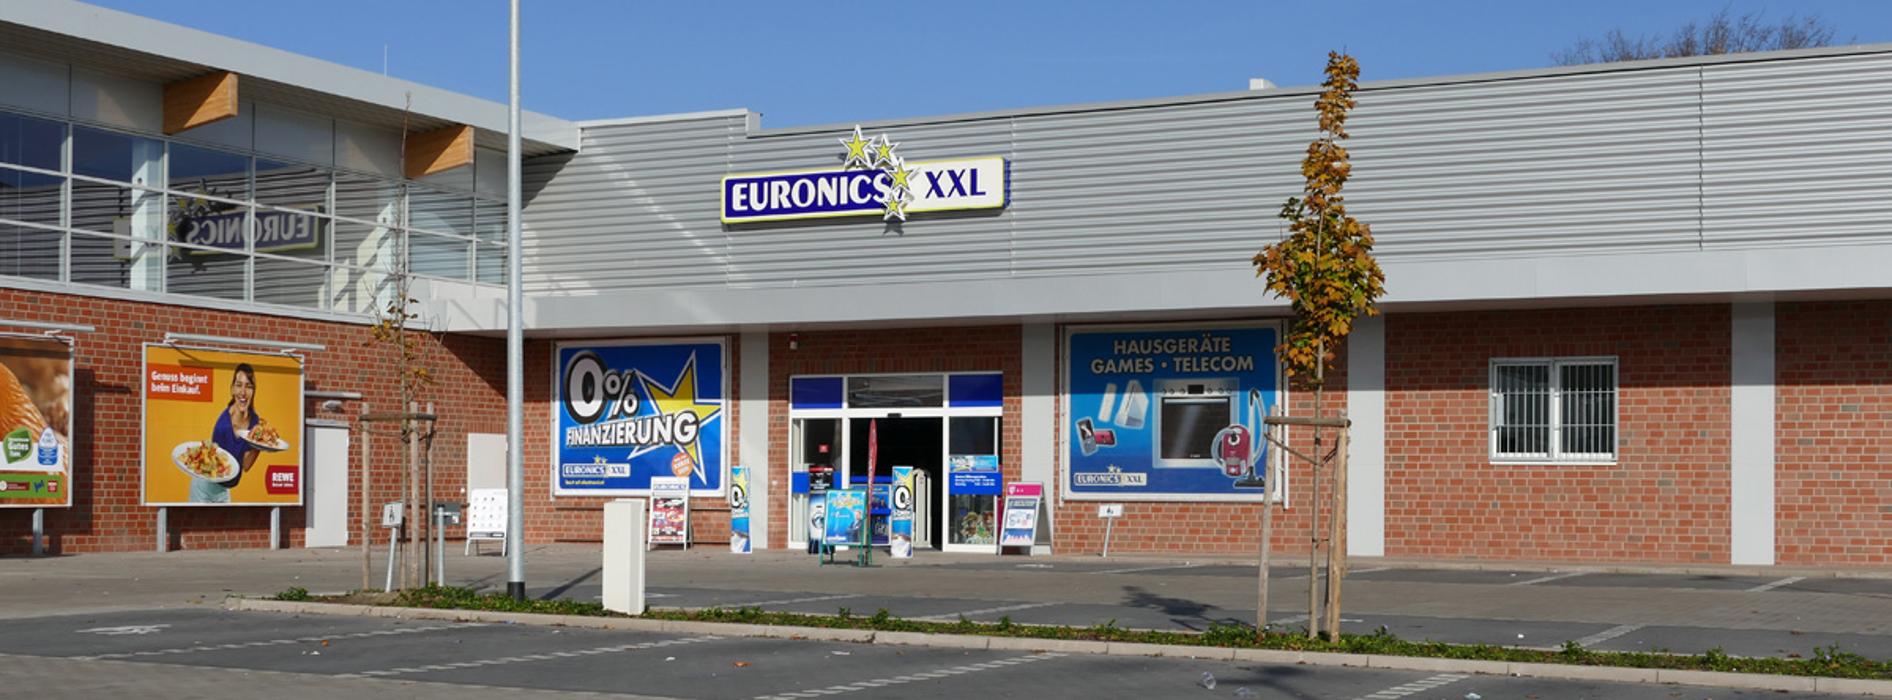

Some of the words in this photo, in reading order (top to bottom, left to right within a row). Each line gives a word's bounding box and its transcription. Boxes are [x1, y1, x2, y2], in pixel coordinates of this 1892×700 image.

[732, 173, 892, 212] EURONICS
[925, 168, 986, 199] XXL
[1113, 333, 1231, 355] HAUSGERÄTE
[1091, 358, 1154, 374] GAMES
[1173, 355, 1253, 372] TELECOM
[151, 371, 178, 382] Genuss
[180, 372, 208, 384] beginnt
[151, 382, 170, 392] beim
[172, 383, 200, 395] Einkauf.
[564, 351, 641, 424] 0%
[566, 410, 700, 446] FINANZIERUNG
[272, 472, 294, 481] REWE
[565, 465, 605, 474] EURONICS
[1077, 475, 1121, 485] EURONICS
[1126, 475, 1144, 484] XXL
